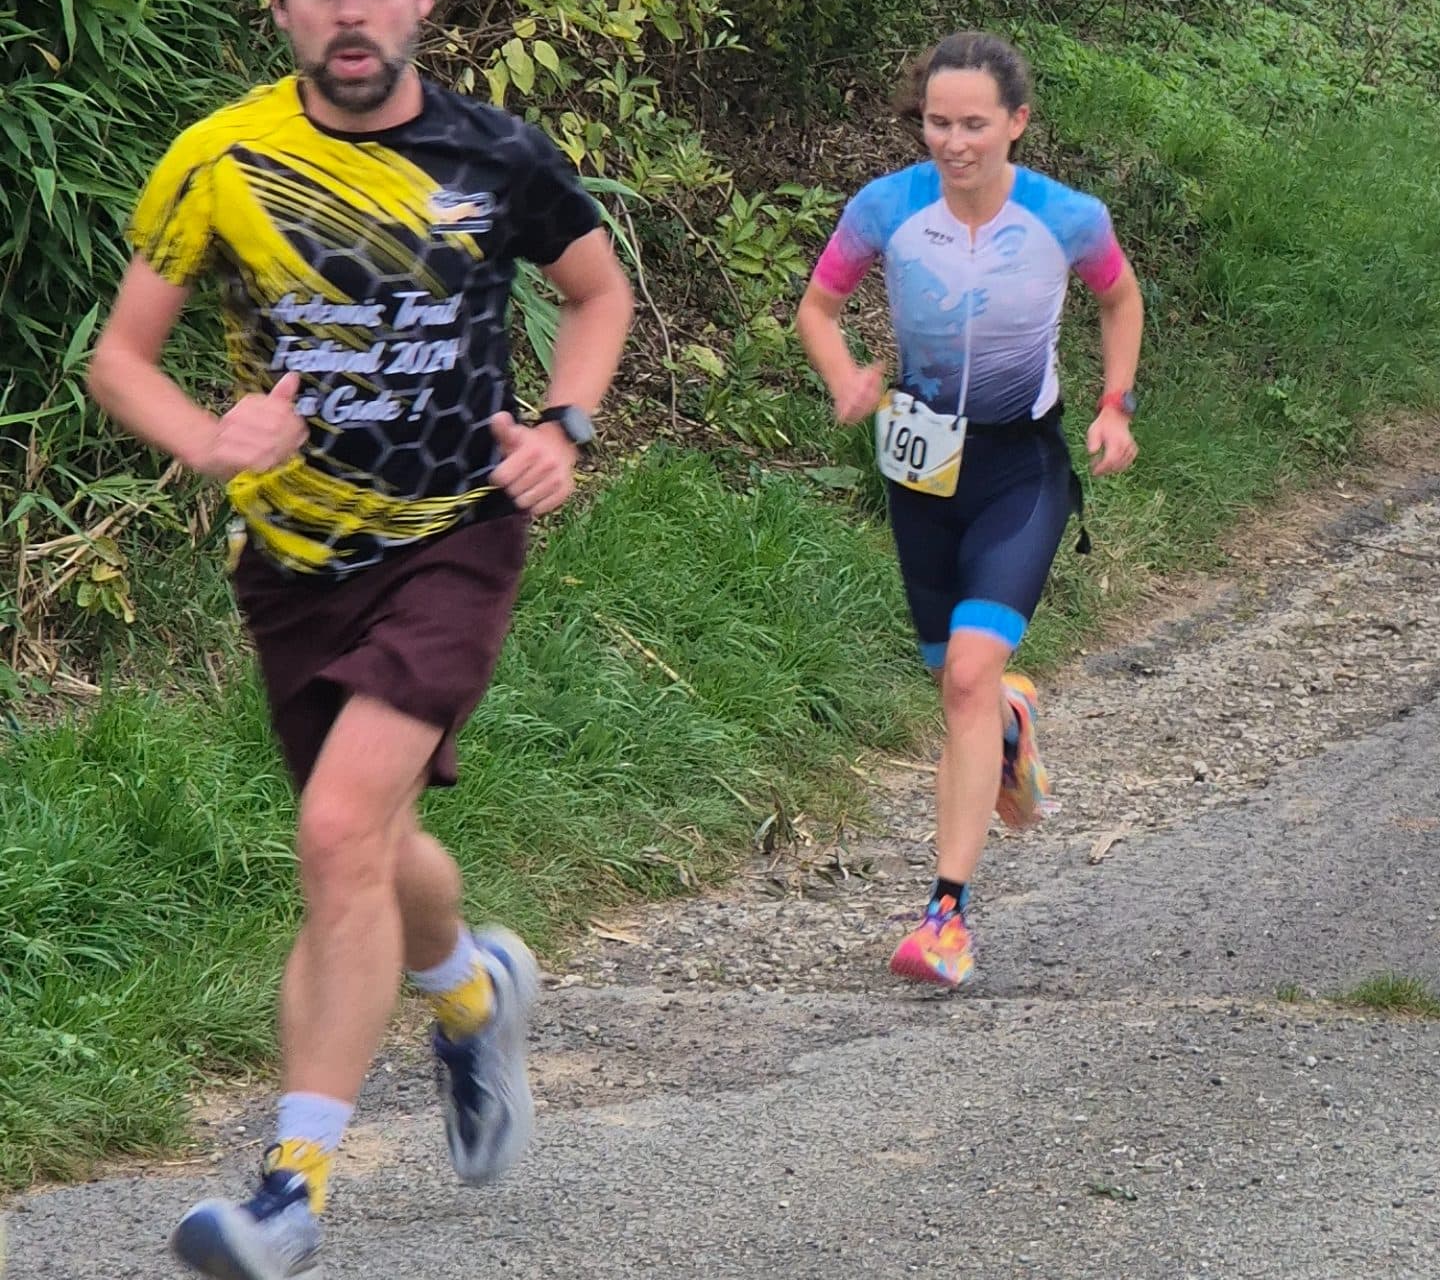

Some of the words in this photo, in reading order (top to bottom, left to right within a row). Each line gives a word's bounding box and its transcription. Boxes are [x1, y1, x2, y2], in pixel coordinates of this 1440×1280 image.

[392, 291, 464, 331] Trail
[271, 335, 386, 374] Festival
[383, 338, 461, 375] 2024
[884, 420, 927, 470] 190
